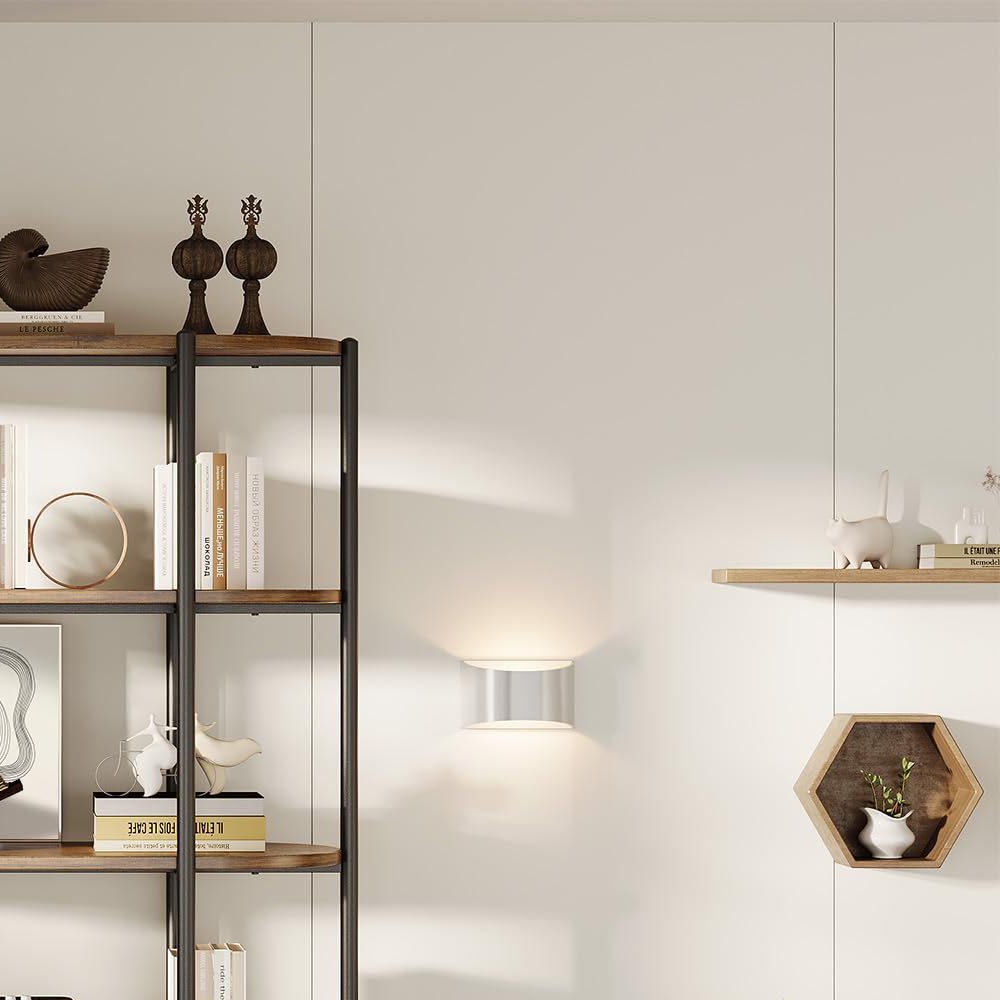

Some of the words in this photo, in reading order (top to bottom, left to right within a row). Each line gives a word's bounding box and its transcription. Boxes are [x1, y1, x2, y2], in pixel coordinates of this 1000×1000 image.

[128, 822, 146, 836] CAFÉ
[149, 822, 157, 833] LE
[159, 822, 175, 833] FOIS
[216, 822, 223, 833] IL
